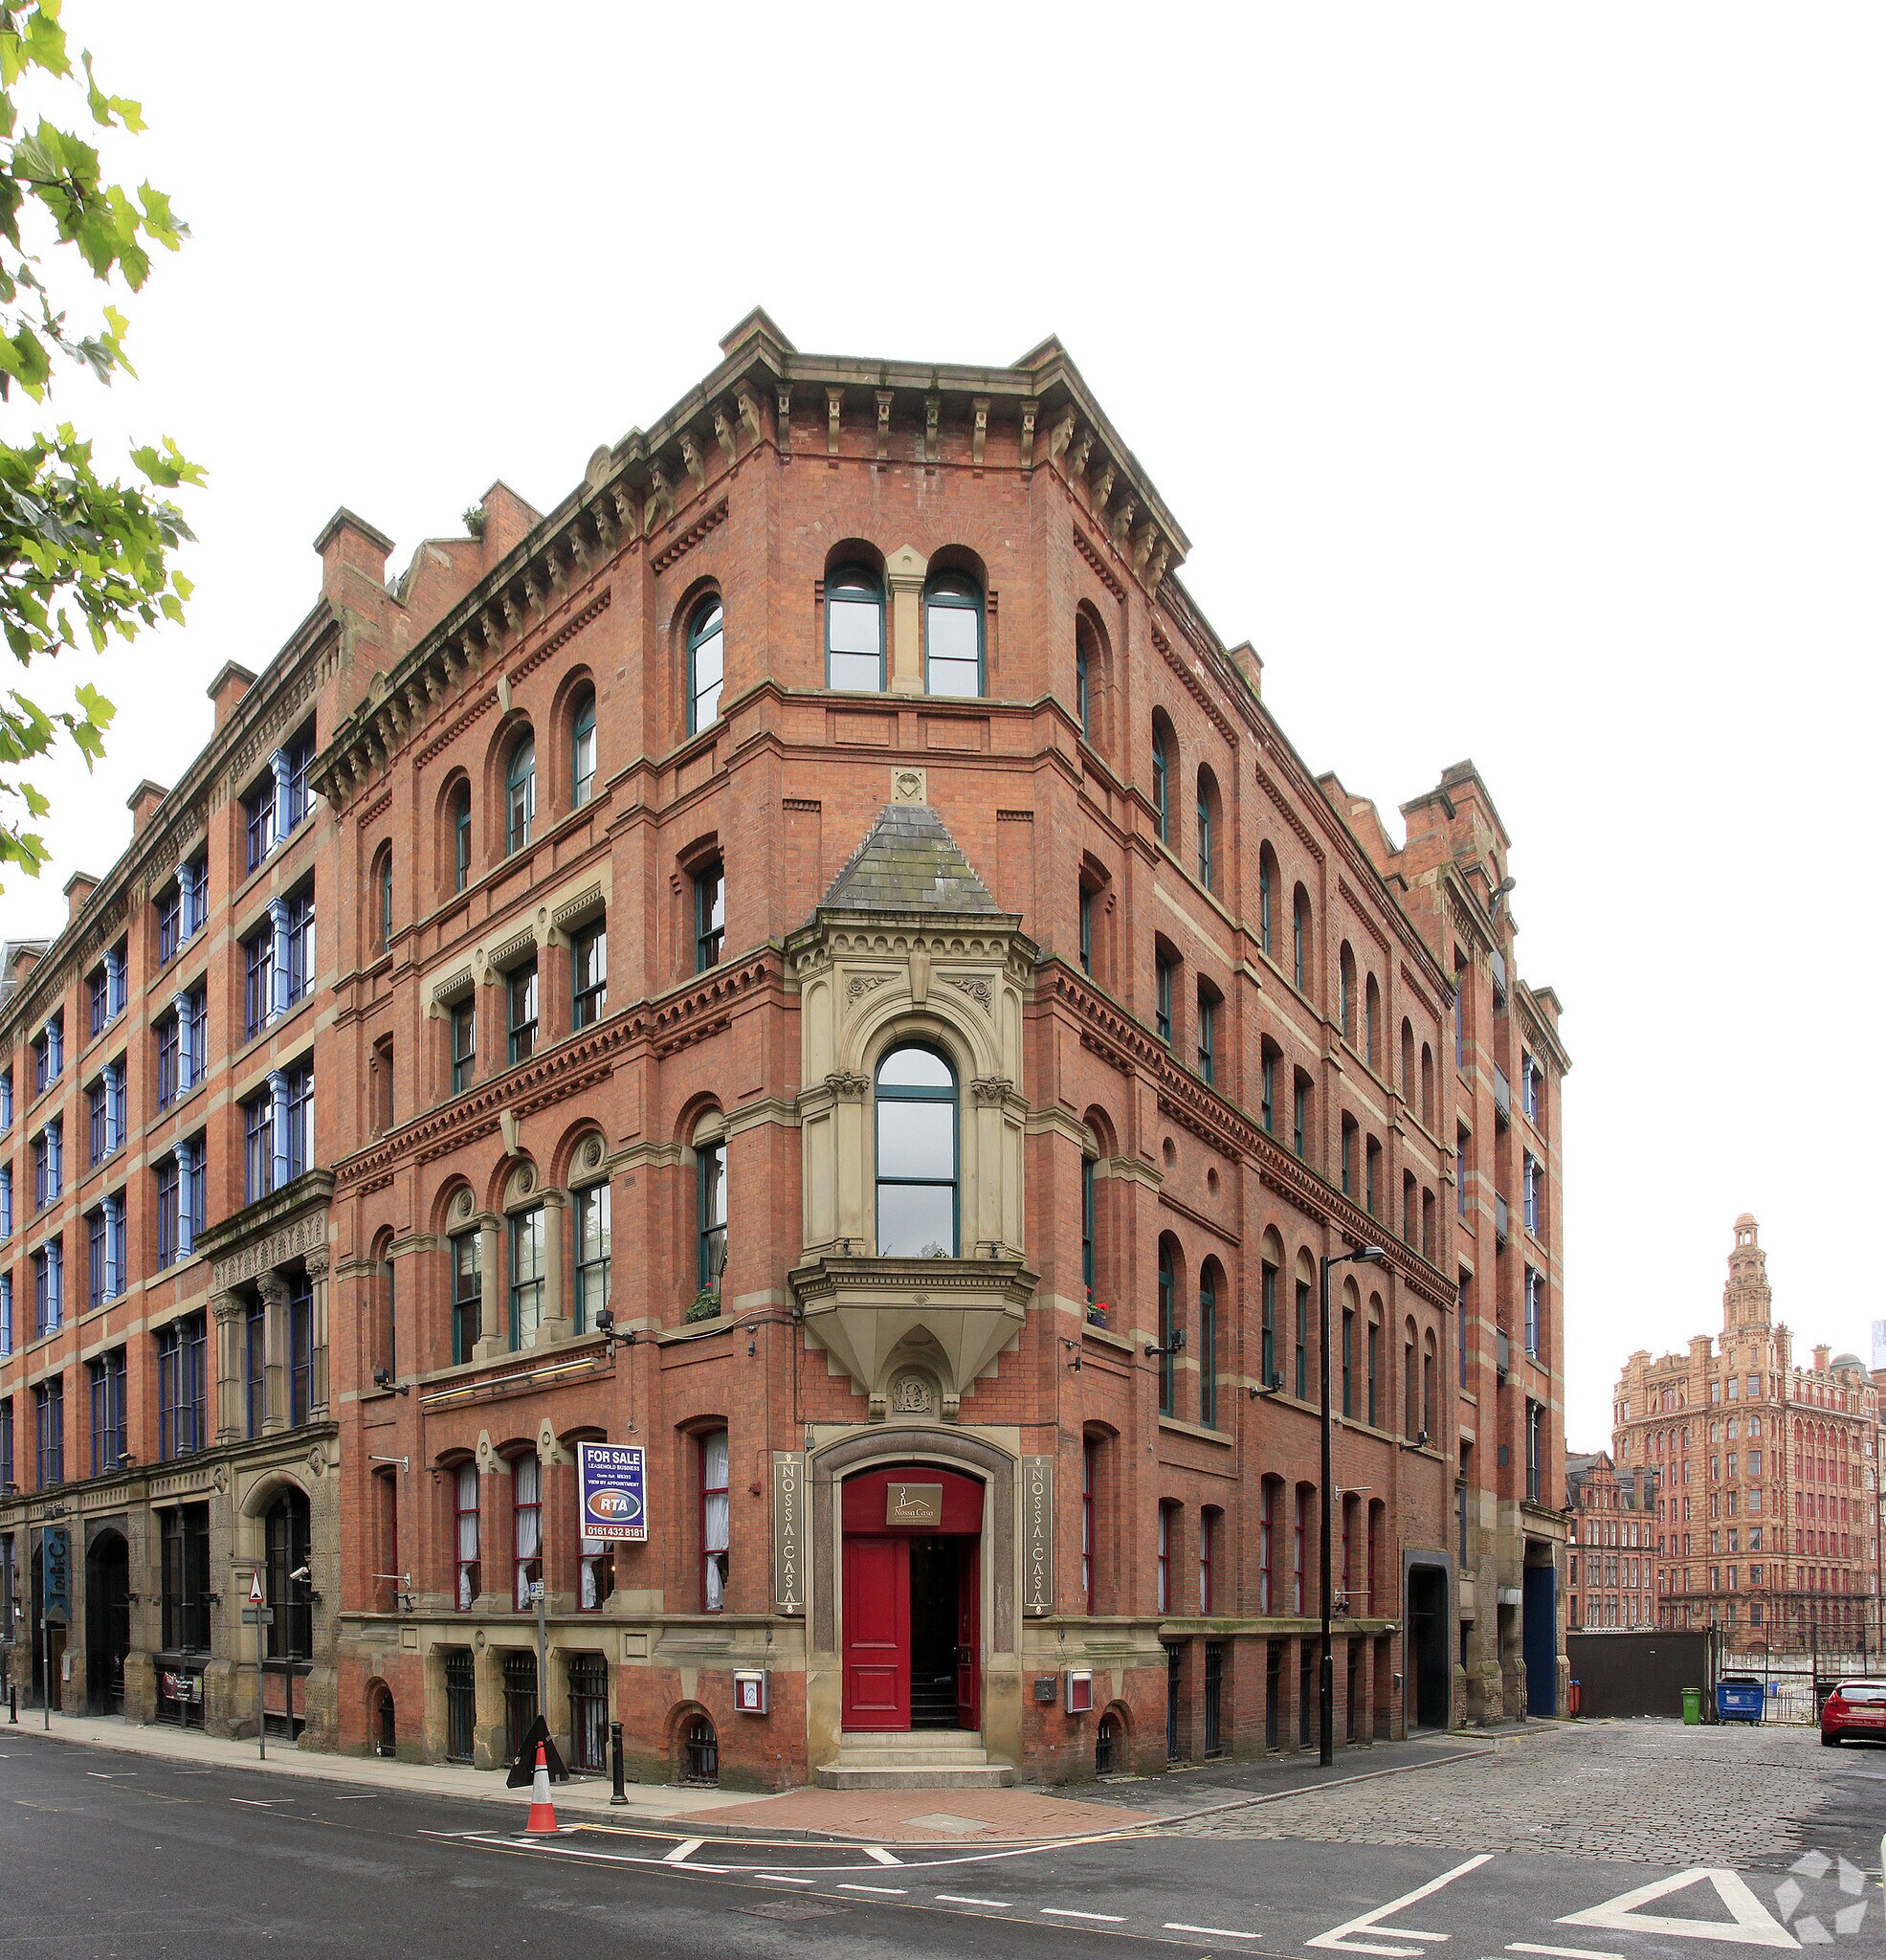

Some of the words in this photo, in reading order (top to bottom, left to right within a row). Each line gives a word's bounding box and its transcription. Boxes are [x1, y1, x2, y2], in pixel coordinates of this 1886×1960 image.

[588, 1450, 610, 1462] FOR
[612, 1452, 640, 1464] SALE
[600, 1498, 628, 1511] RTA
[782, 1464, 795, 1536] NOSSA
[916, 1508, 934, 1517] Casa
[1032, 1467, 1044, 1538] NOSSA
[588, 1526, 608, 1535] 0161
[608, 1527, 624, 1536] 432
[625, 1527, 644, 1537] 8181
[783, 1546, 796, 1602] CASA
[1032, 1548, 1045, 1603] CASA
